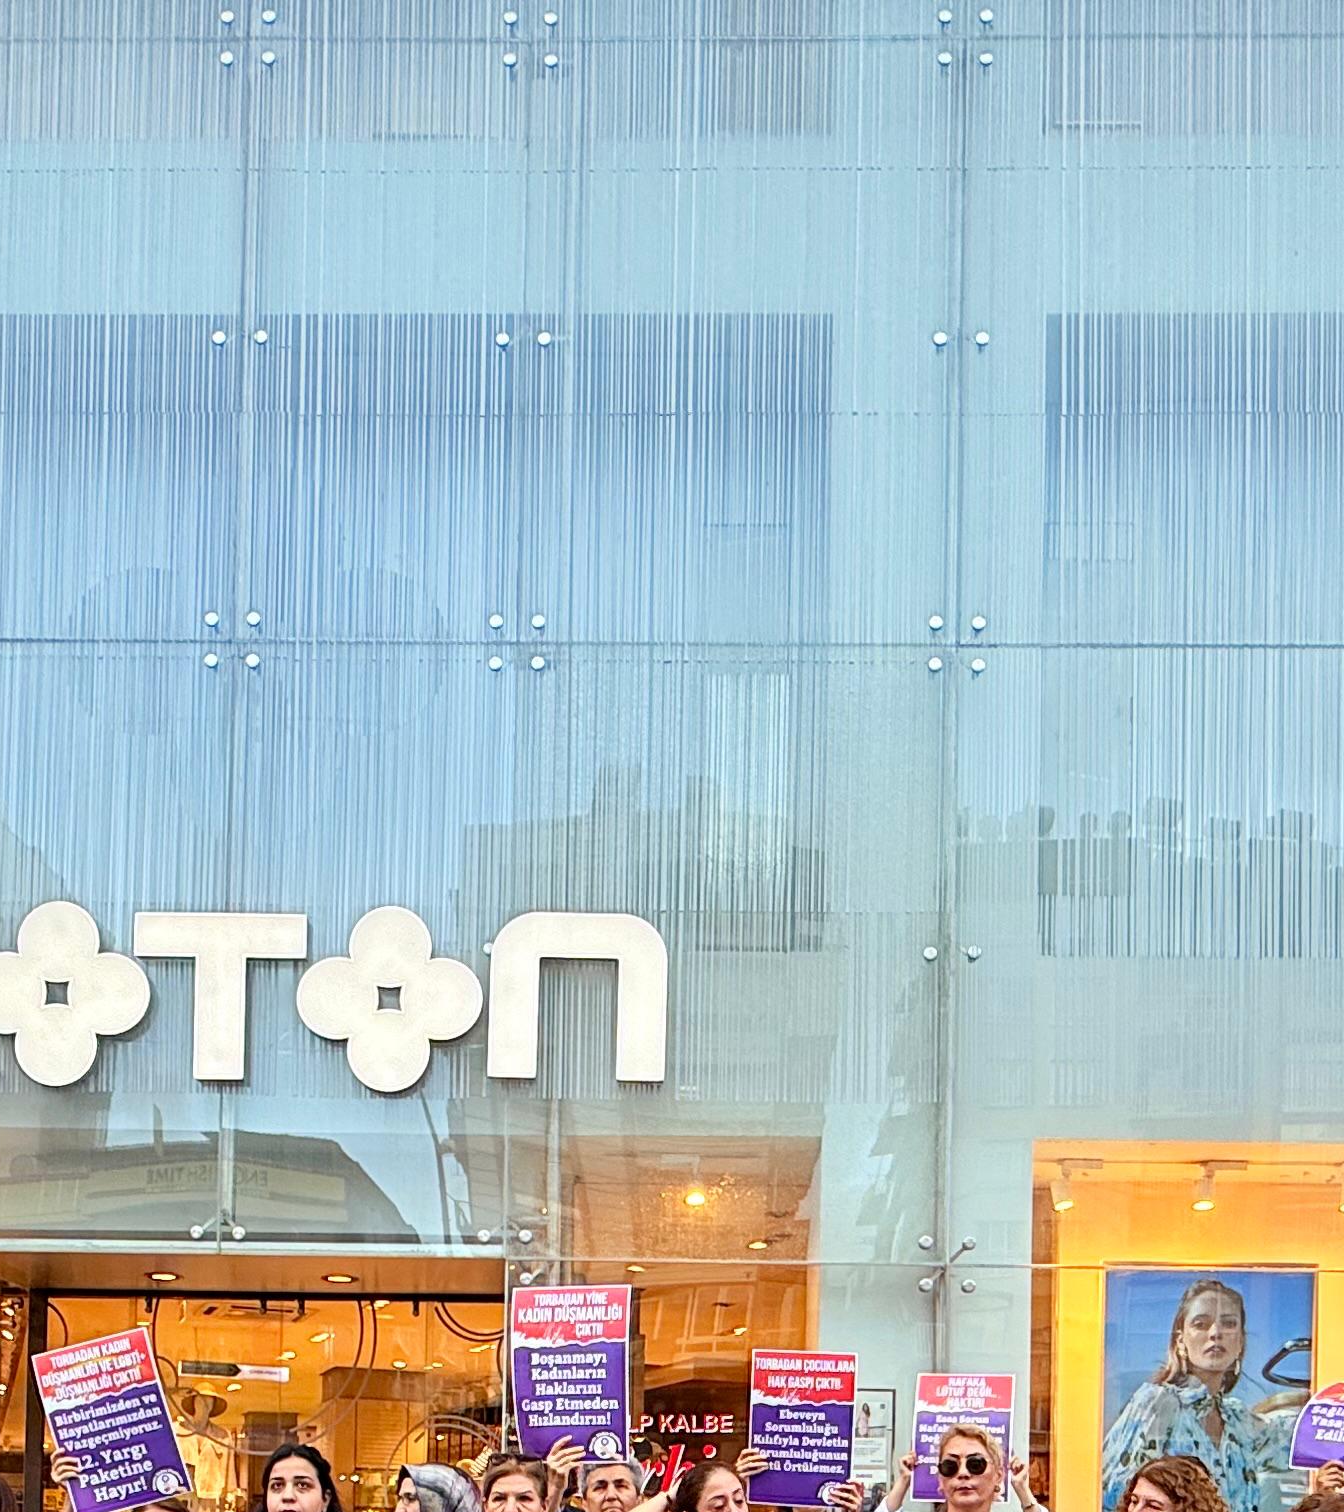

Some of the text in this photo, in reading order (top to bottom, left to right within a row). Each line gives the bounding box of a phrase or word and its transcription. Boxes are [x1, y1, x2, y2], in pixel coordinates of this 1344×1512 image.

[518, 1303, 623, 1324] KADIN DÜŞMANLIĞI
[530, 1352, 607, 1367] Boşanmayı
[531, 1367, 607, 1381] Kadınların
[535, 1382, 602, 1396] Haklarını
[54, 1393, 158, 1428] Birbirimizden ve
[521, 1397, 619, 1413] Gasp Etmeden
[57, 1406, 162, 1440] Hayatlarımızdan
[528, 1413, 612, 1427] Hızlandırın!
[659, 1414, 734, 1434] KALBE
[779, 1409, 826, 1423] Ebeveyn
[64, 1420, 164, 1452] Vazgeçmiyoruz.
[765, 1421, 839, 1436] Sorumluluğu
[753, 1434, 849, 1448] Kılıfıyla Devletin
[99, 1443, 148, 1464] Yargı
[768, 1460, 781, 1471] tü
[78, 1460, 154, 1489] Paketine
[93, 1476, 148, 1503] Hayır!
